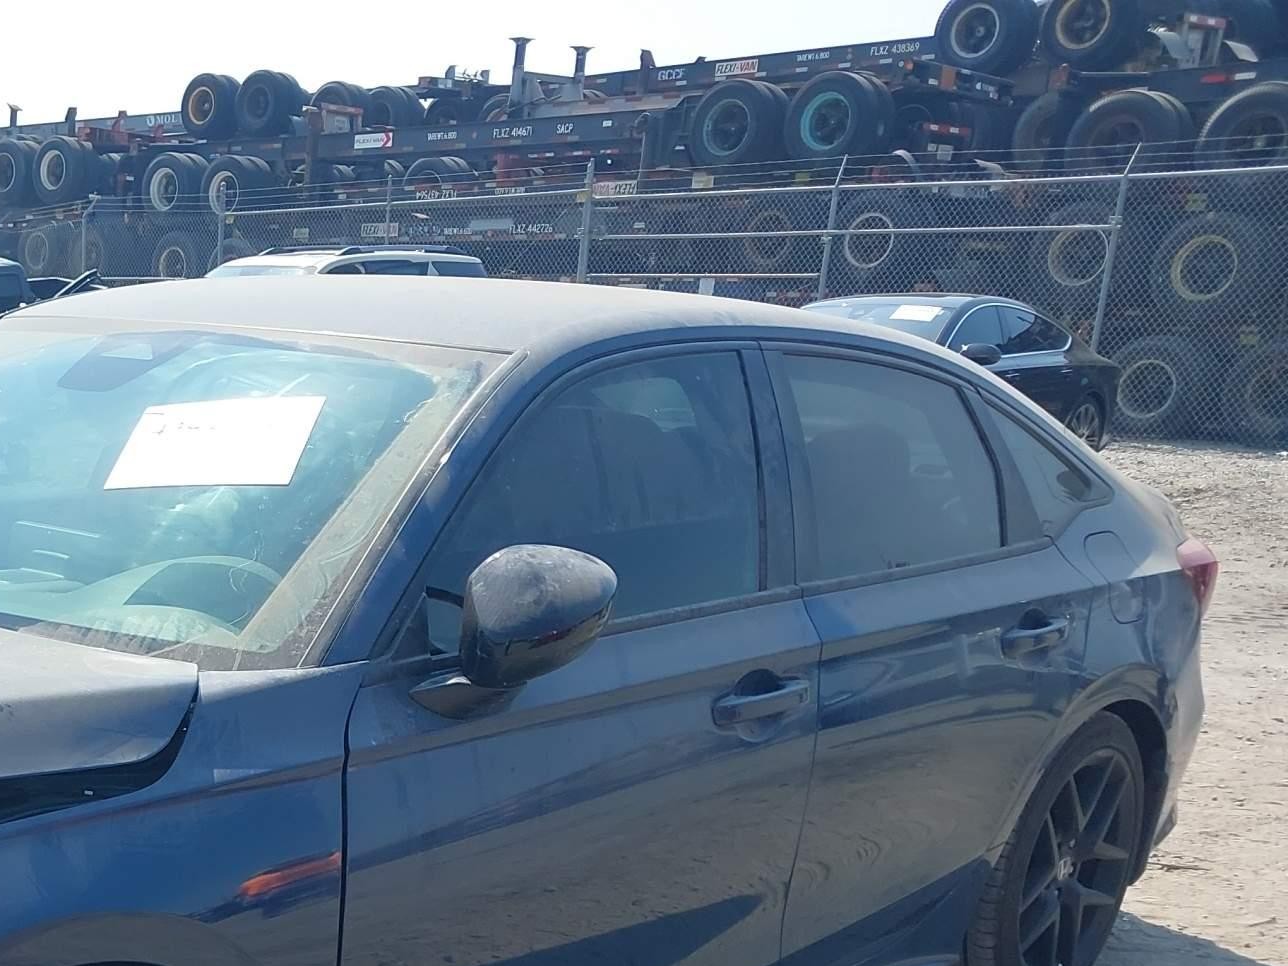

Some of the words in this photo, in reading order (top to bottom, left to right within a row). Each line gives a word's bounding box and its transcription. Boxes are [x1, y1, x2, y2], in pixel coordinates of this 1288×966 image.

[870, 45, 889, 56] FLXZ
[892, 42, 920, 54] 438369
[716, 60, 758, 75] FLEXI-VAN
[493, 127, 510, 139] FLXZ
[511, 126, 533, 137] 414671
[556, 123, 574, 134] SACP
